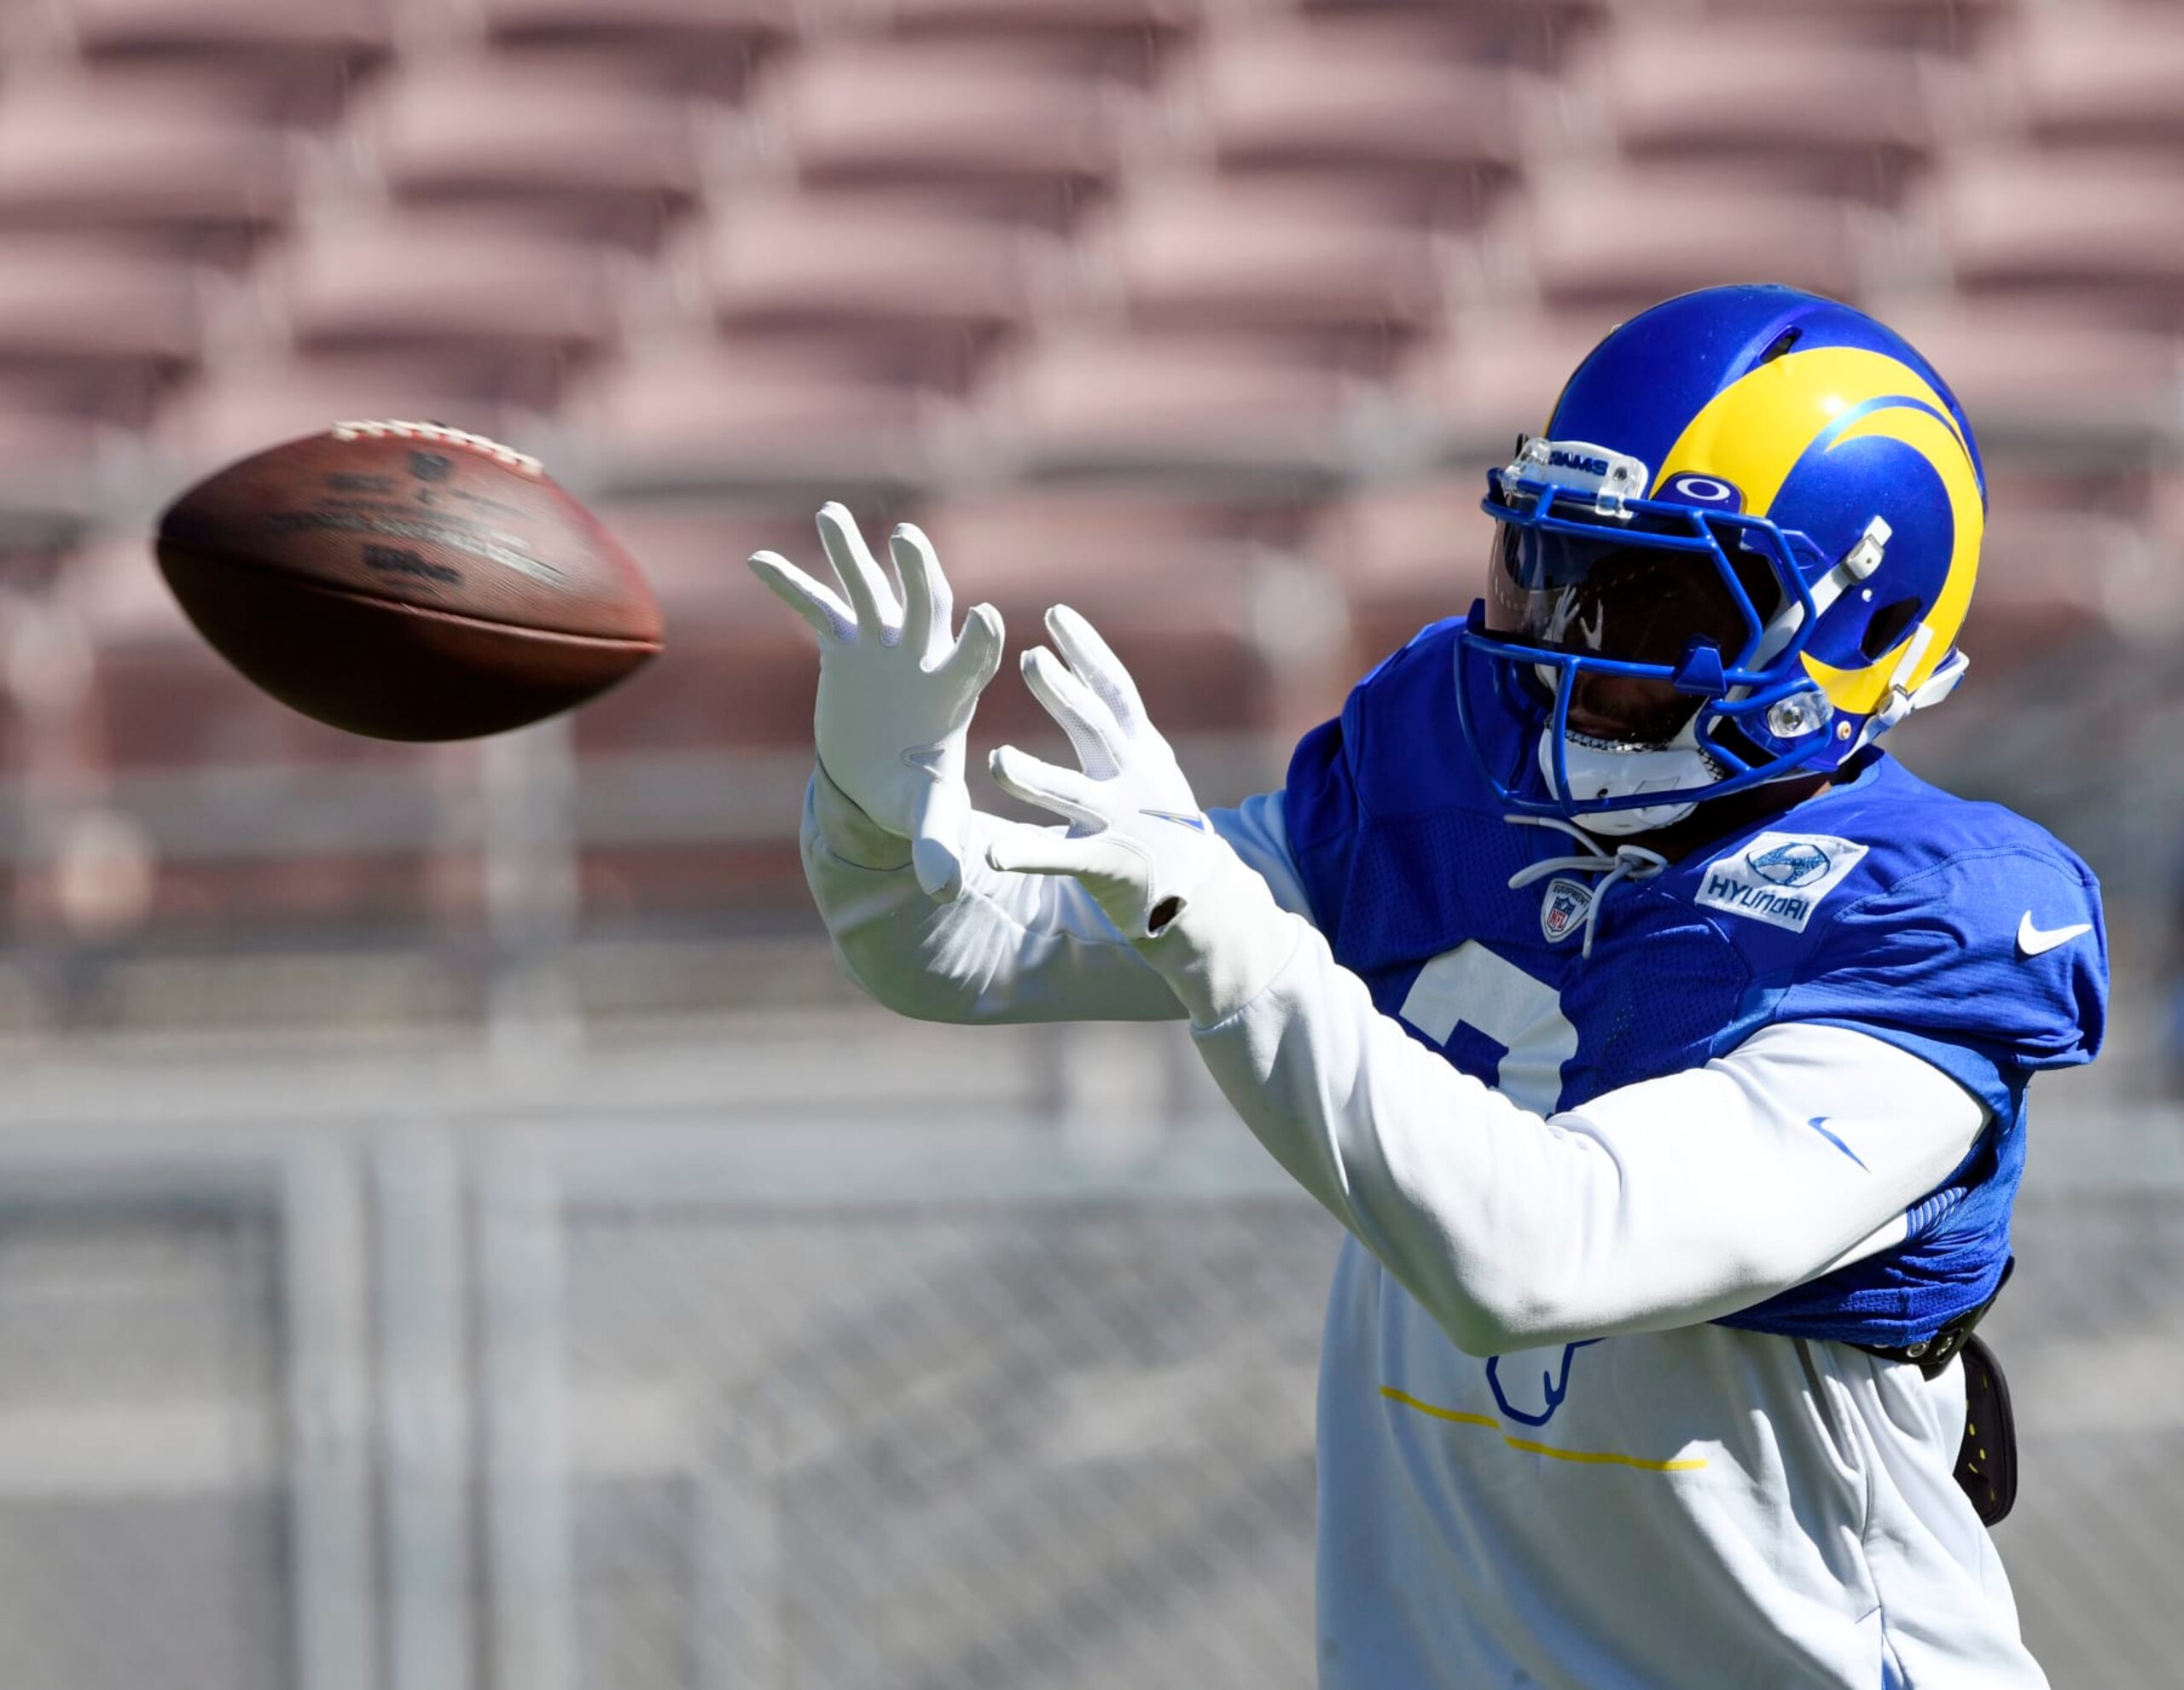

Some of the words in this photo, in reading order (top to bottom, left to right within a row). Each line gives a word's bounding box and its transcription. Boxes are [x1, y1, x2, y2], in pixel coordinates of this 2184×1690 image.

[1548, 450, 1609, 476] RAMS
[1707, 874, 1810, 920] HYUNDAI
[1548, 909, 1567, 930] NFL
